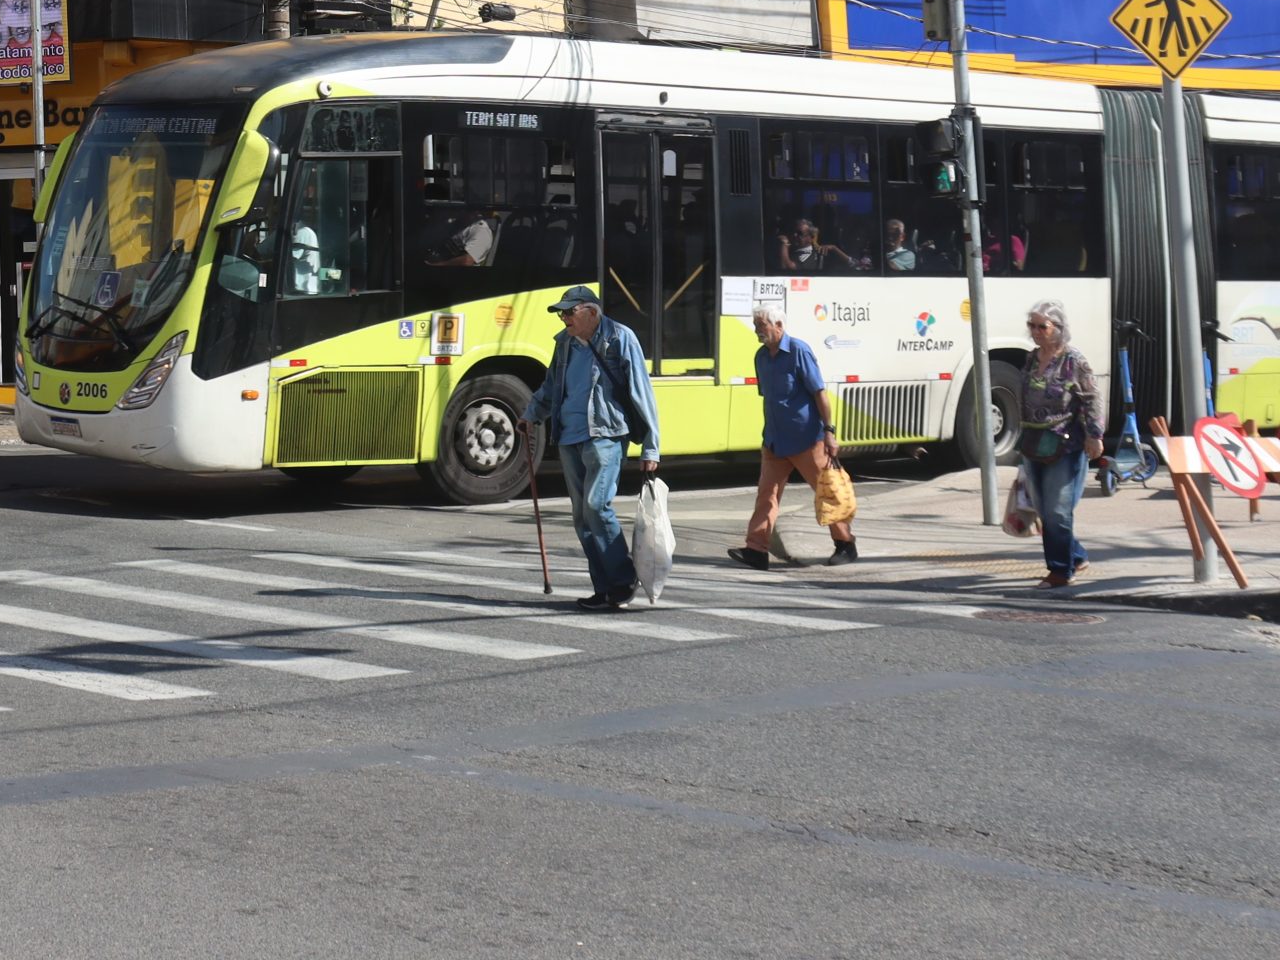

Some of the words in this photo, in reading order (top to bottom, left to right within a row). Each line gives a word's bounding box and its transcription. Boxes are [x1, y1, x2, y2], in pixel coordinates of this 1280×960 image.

[465, 111, 494, 126] TERM
[496, 113, 517, 127] SAT
[760, 283, 784, 295] BRT20
[832, 302, 871, 326] Itajaí
[76, 382, 108, 398] 2006
